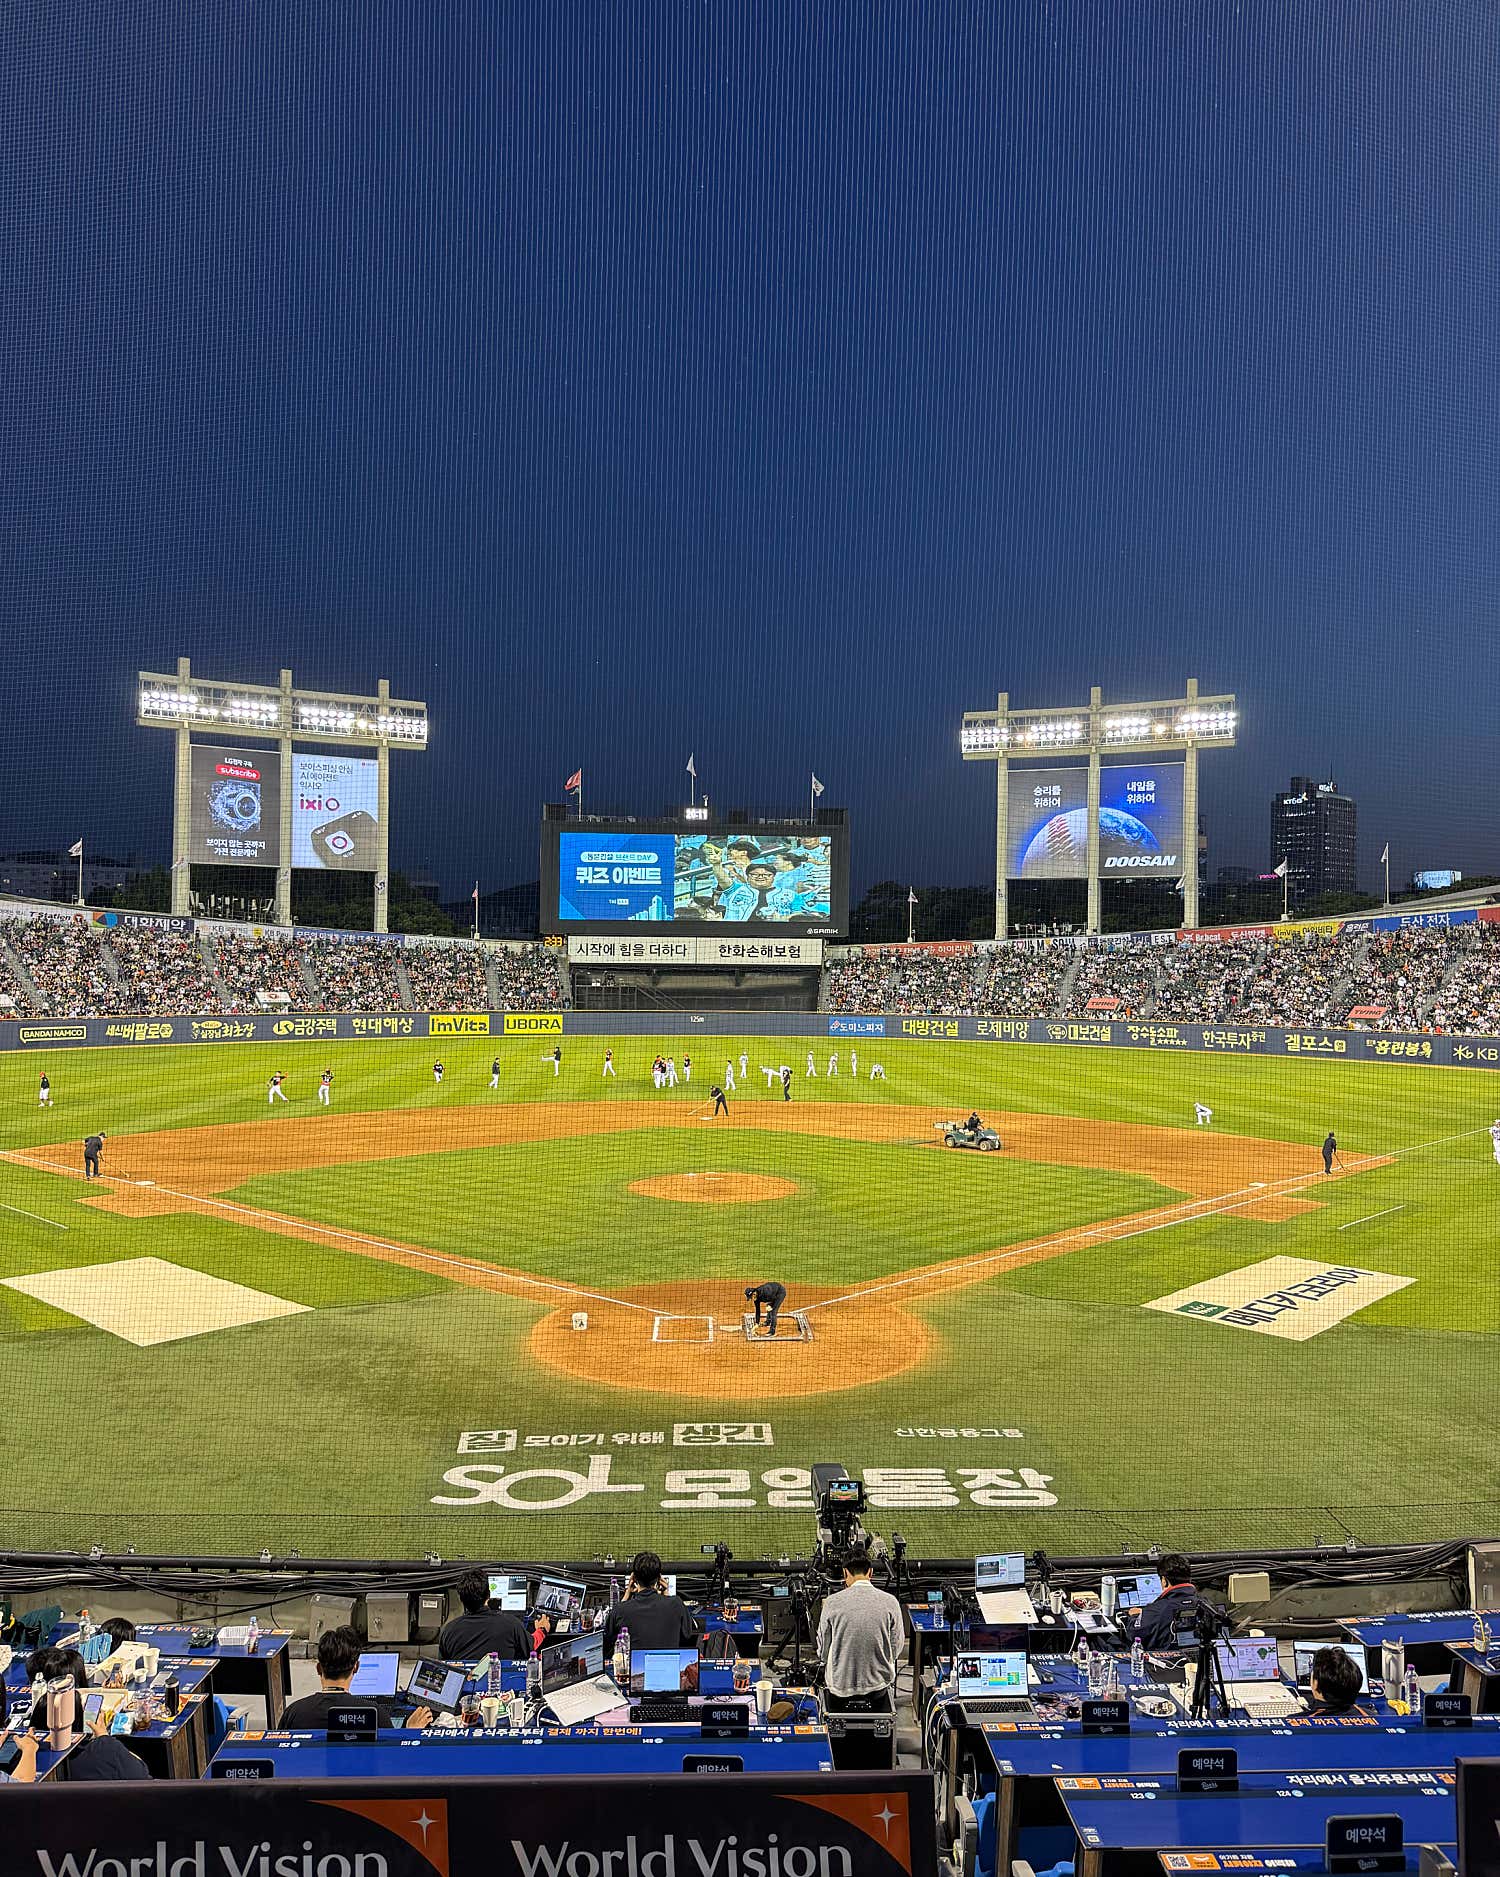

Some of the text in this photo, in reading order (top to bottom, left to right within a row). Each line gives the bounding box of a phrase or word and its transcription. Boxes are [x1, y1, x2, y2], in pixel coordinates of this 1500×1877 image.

[221, 767, 257, 778] subscribe
[1033, 785, 1062, 797] 승리를
[1126, 780, 1157, 793] 내일을
[1033, 797, 1061, 808] 위하여
[1126, 793, 1156, 805] 위하여
[206, 838, 228, 848] 보이지
[615, 853, 636, 862] 브랜드
[1104, 855, 1177, 869] DOOSAN
[576, 866, 662, 885] 퀴즈 이벤트
[38, 912, 72, 922] Station
[124, 915, 187, 932] 대화제약
[1400, 913, 1451, 929] 두산 전자
[577, 943, 689, 957] 시작에 힘을 더하다
[718, 944, 802, 959] 한화손해보험
[506, 1018, 562, 1031] UBORA
[690, 1015, 705, 1023] 125m
[294, 1018, 337, 1037] 금강주택
[352, 1017, 414, 1036] 현대해상
[839, 1021, 884, 1034] 도미노피자
[902, 1019, 959, 1038] 대방건설
[977, 1021, 1030, 1041] 로제비앙
[1068, 1024, 1111, 1042] 대보건설
[24, 1028, 84, 1039] BANDAI NAMCO
[1127, 1025, 1179, 1046] 장수돌소파
[1284, 1033, 1334, 1053] 겔포스
[1476, 1047, 1499, 1063] KB
[1218, 1266, 1375, 1327] 메디카코리아
[523, 1433, 605, 1448] 모이기
[611, 1431, 665, 1447] 위해
[677, 1424, 771, 1446] 생긴
[893, 1426, 1025, 1439] 신한금융그룹
[429, 1454, 646, 1510] SOL
[1435, 1699, 1461, 1711] 예약석
[712, 1709, 739, 1722] 예약석
[1092, 1706, 1119, 1718] 예약석
[338, 1713, 366, 1726] 예약석
[1166, 1716, 1379, 1729] 자리에서 음식주문부터 결제 까지 한번에!
[420, 1726, 642, 1738] 자리에서 음식주문부터 결제 까지 한번에!
[1192, 1757, 1224, 1771] 예약석
[226, 1767, 260, 1779] 예약석
[1286, 1774, 1348, 1786] 자리에서
[1349, 1773, 1437, 1786] 음식주문부터
[1130, 1792, 1145, 1800] 123
[1345, 1826, 1387, 1844] 예약석
[36, 1840, 389, 1877] World Vision
[510, 1832, 854, 1877] World Vision
